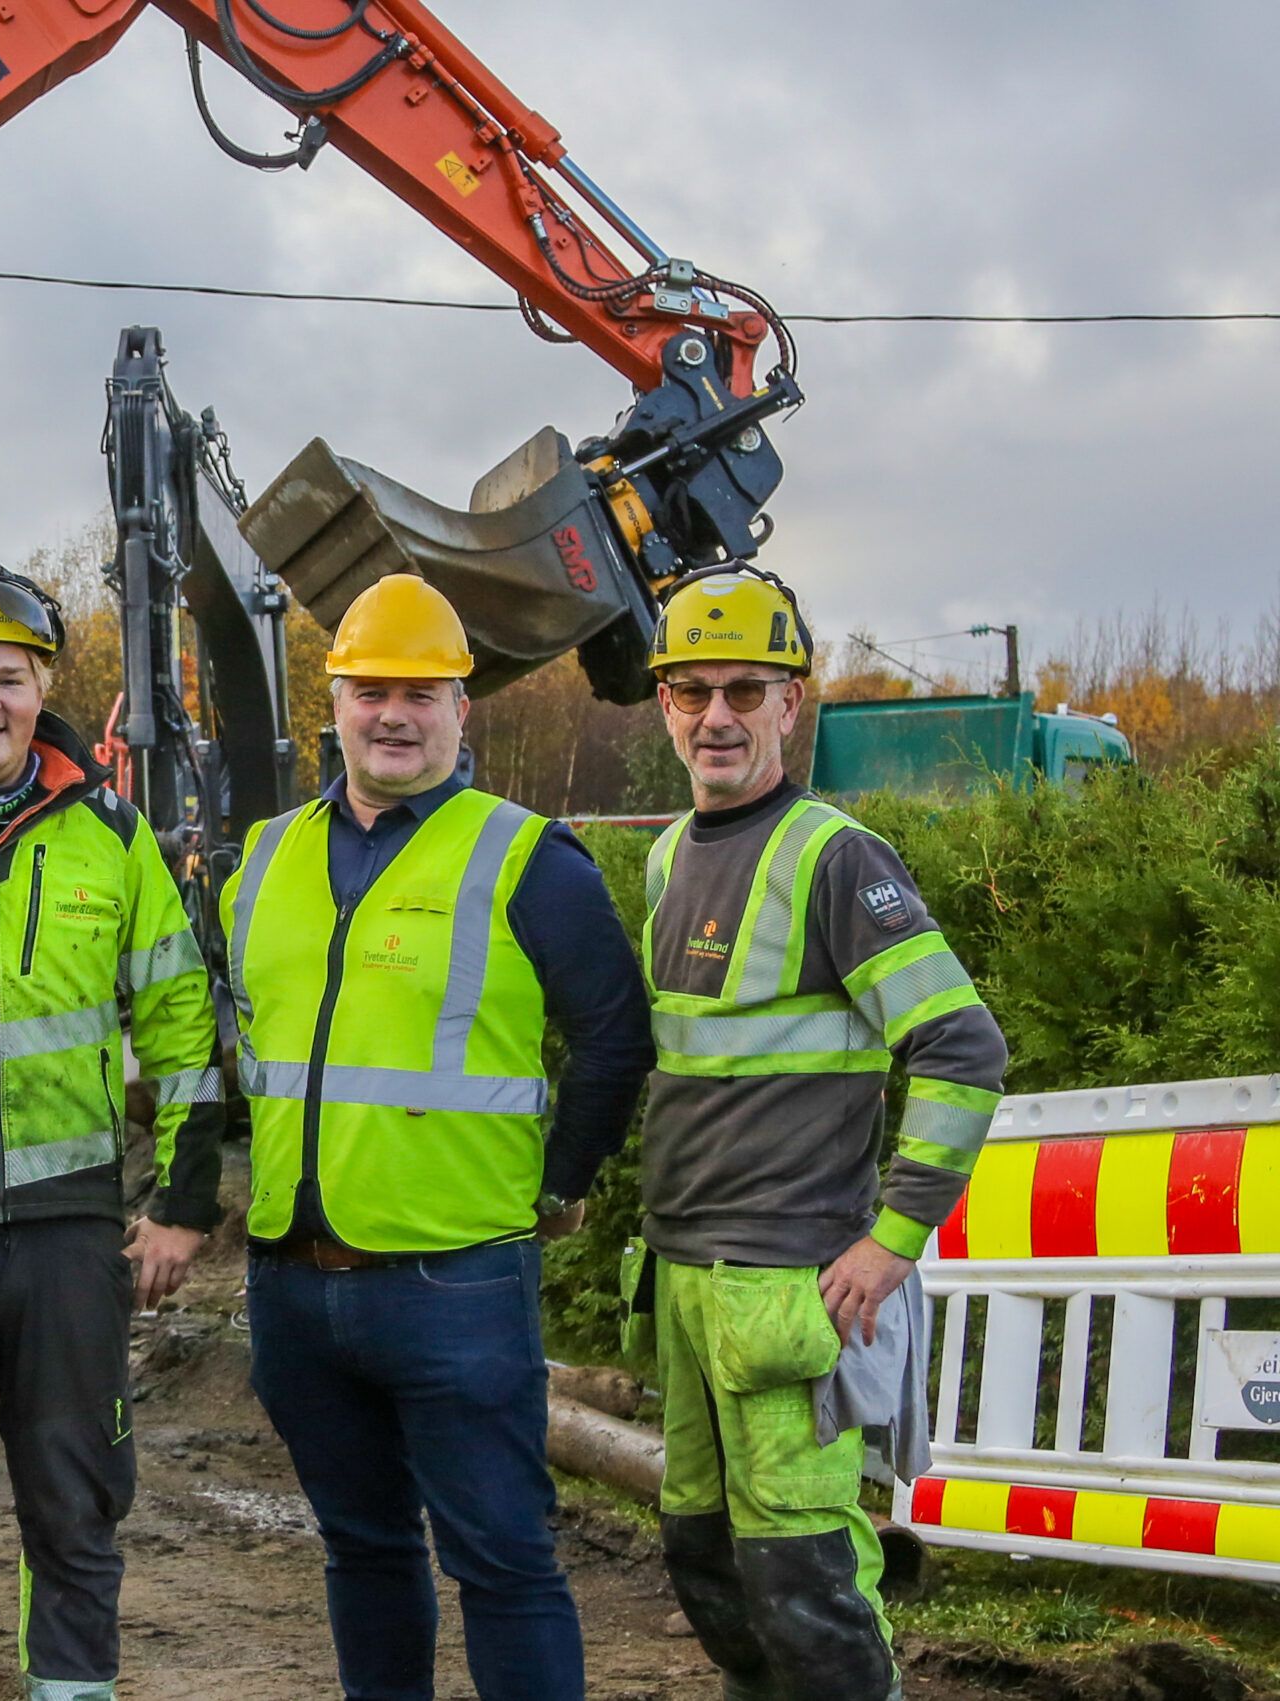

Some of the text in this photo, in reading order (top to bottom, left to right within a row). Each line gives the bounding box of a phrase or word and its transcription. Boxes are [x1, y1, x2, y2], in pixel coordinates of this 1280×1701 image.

[624, 501, 642, 534] engco
[551, 525, 597, 592] SMP
[705, 631, 743, 640] Guardio
[866, 883, 899, 907] HH
[55, 901, 79, 913] Tveter
[710, 940, 729, 954] Lund
[364, 951, 419, 966] Tveter & Lund
